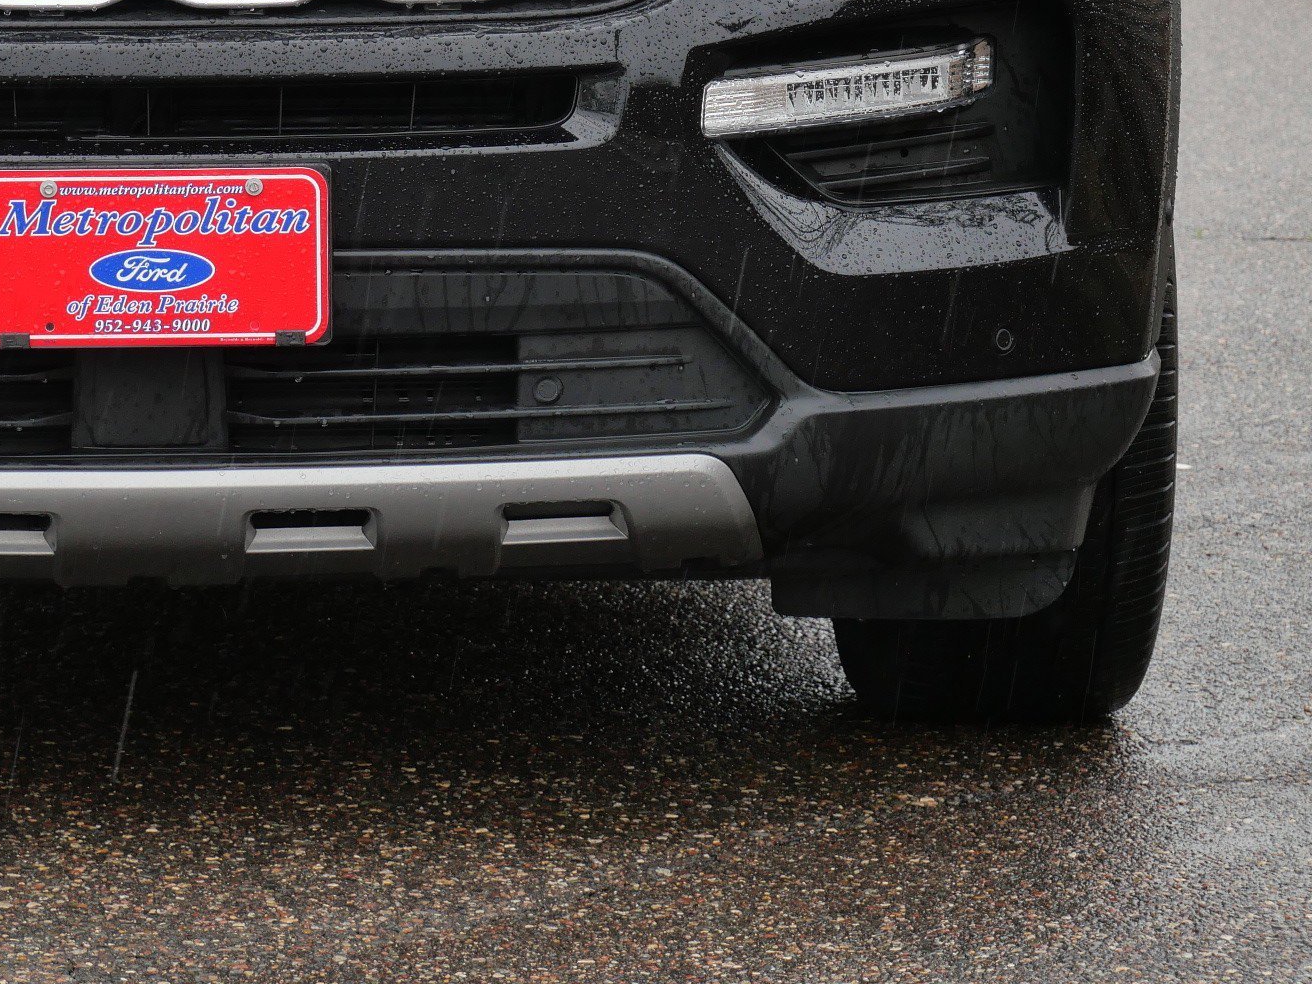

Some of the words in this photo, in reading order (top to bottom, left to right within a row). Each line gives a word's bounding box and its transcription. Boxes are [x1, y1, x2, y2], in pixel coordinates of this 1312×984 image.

[59, 183, 244, 198] www.metropolitanford.com
[116, 255, 188, 283] Ford
[66, 294, 92, 321] of
[93, 295, 153, 315] Eden
[156, 293, 239, 315] Prairie
[94, 318, 211, 333] 952-943-9000
